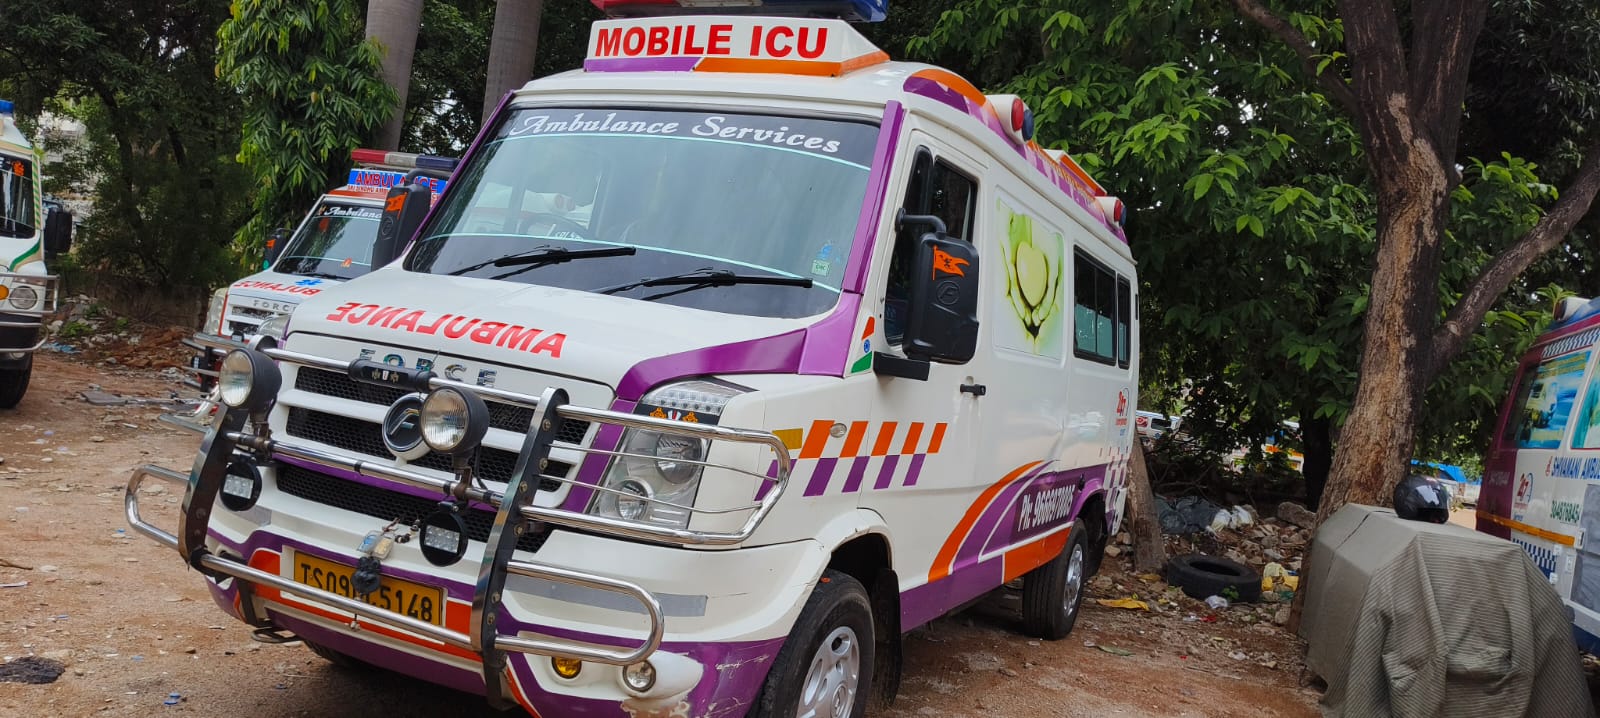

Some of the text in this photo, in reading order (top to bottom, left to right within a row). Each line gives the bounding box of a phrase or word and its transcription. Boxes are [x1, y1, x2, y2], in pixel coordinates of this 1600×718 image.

[594, 24, 828, 59] MOBILE ICU
[509, 112, 841, 153] Ambulance Services
[323, 206, 383, 218] Ambulanc
[253, 299, 297, 312] FORC
[359, 348, 498, 387] FORCE
